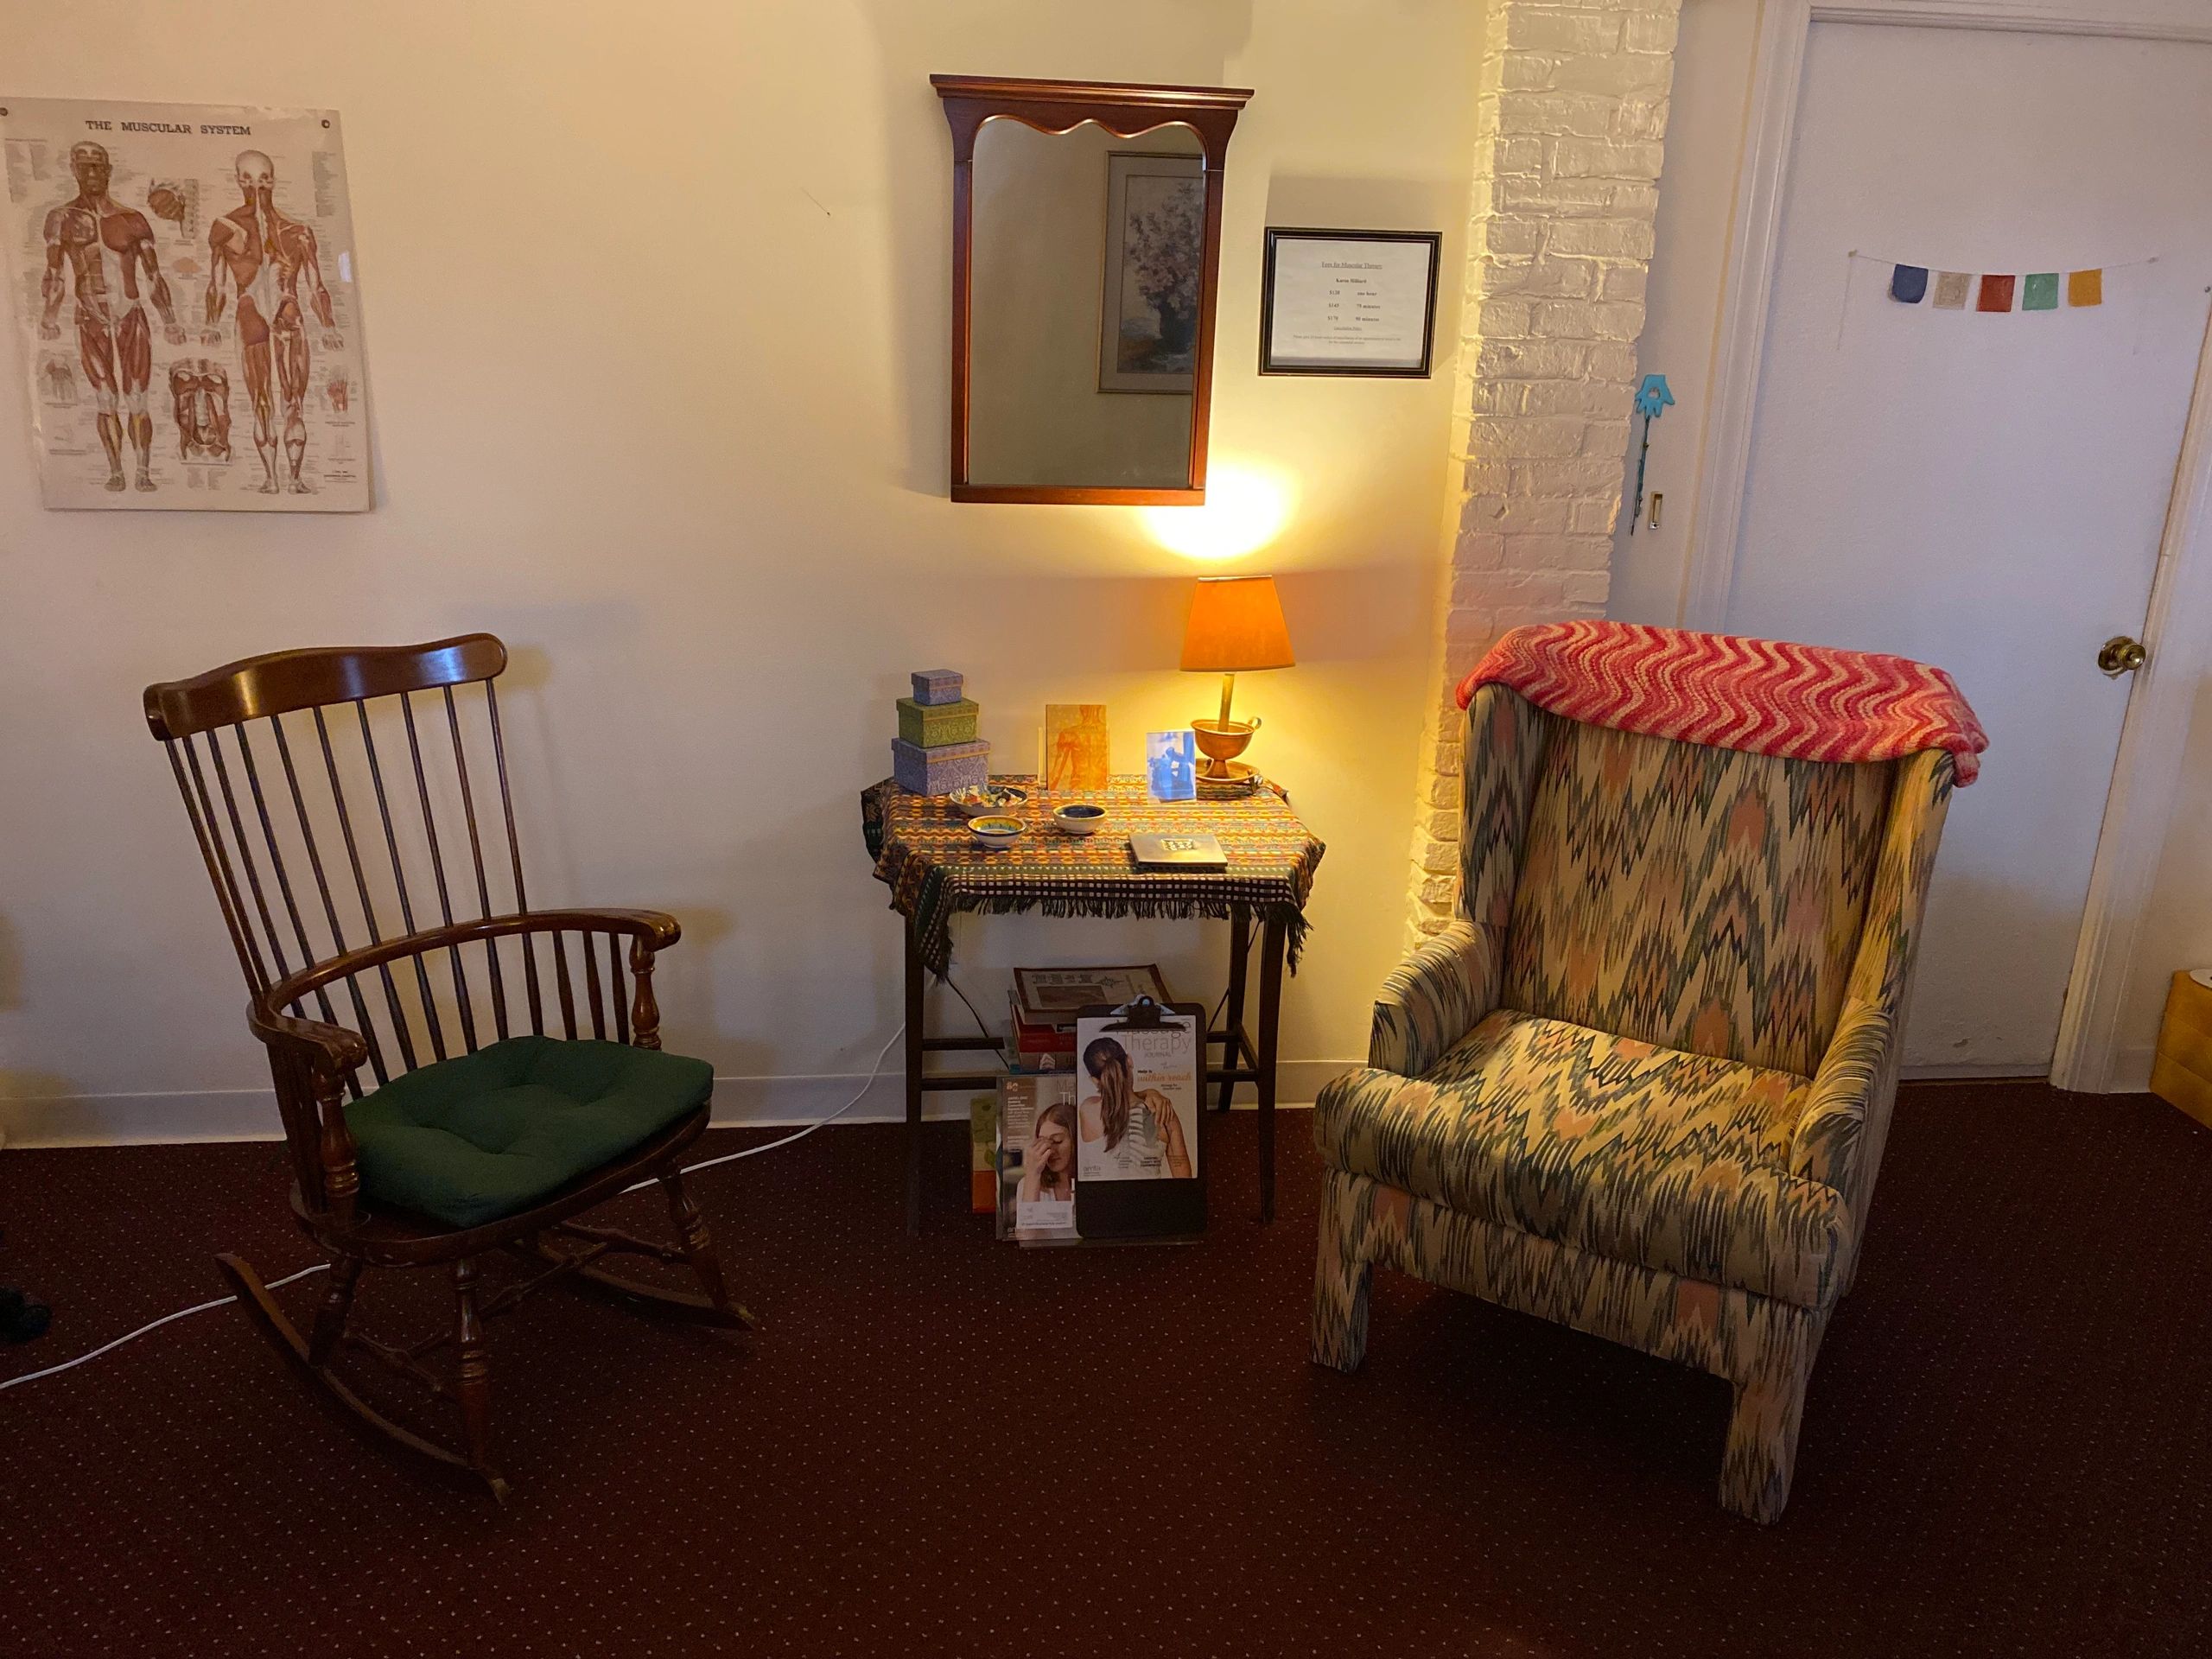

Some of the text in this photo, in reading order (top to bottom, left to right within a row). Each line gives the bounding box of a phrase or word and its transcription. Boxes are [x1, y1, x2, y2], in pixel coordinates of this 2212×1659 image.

[85, 120, 251, 136] THE MUSCULAR SYSTEM
[1122, 1034, 1192, 1054] Therapy
